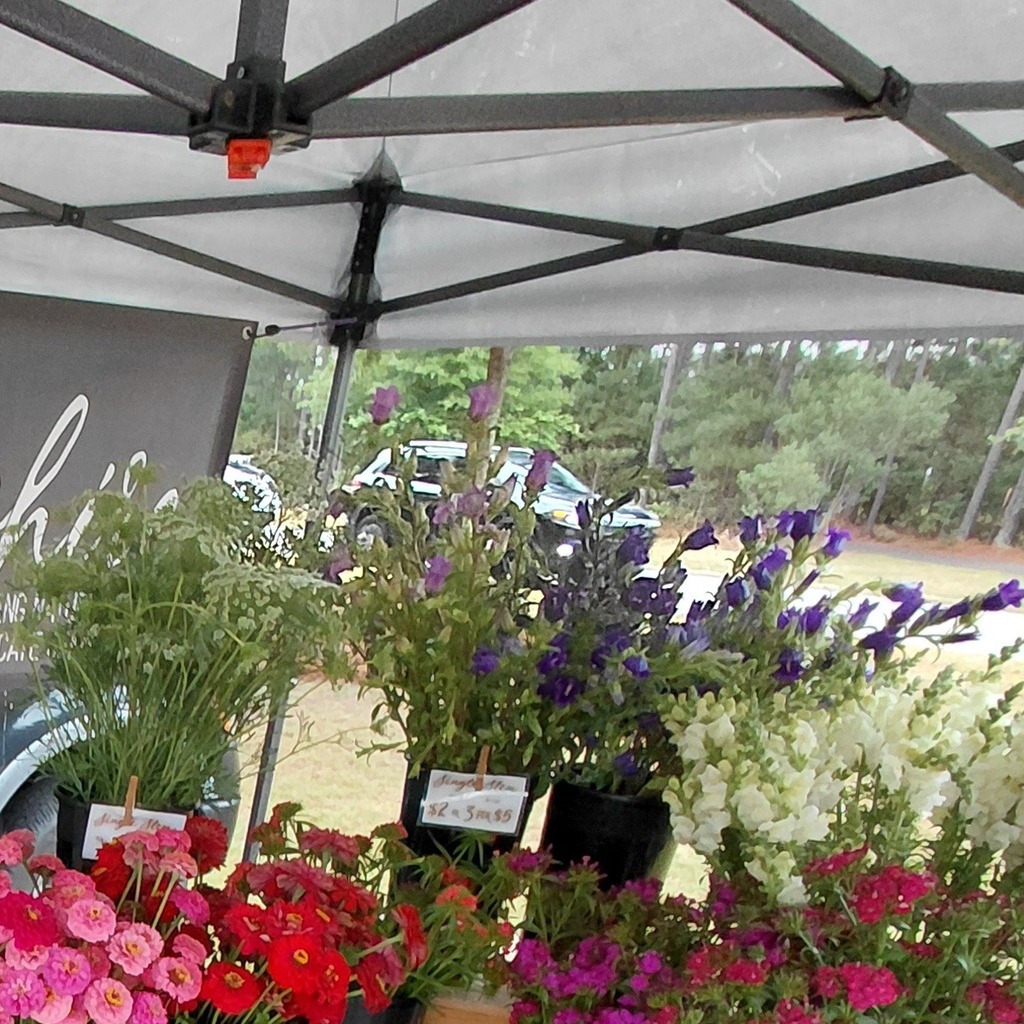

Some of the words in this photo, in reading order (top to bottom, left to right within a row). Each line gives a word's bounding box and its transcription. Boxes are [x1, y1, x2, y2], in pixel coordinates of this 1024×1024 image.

[428, 802, 449, 818] $2
[463, 805, 475, 822] 3
[494, 809, 513, 823] $5
